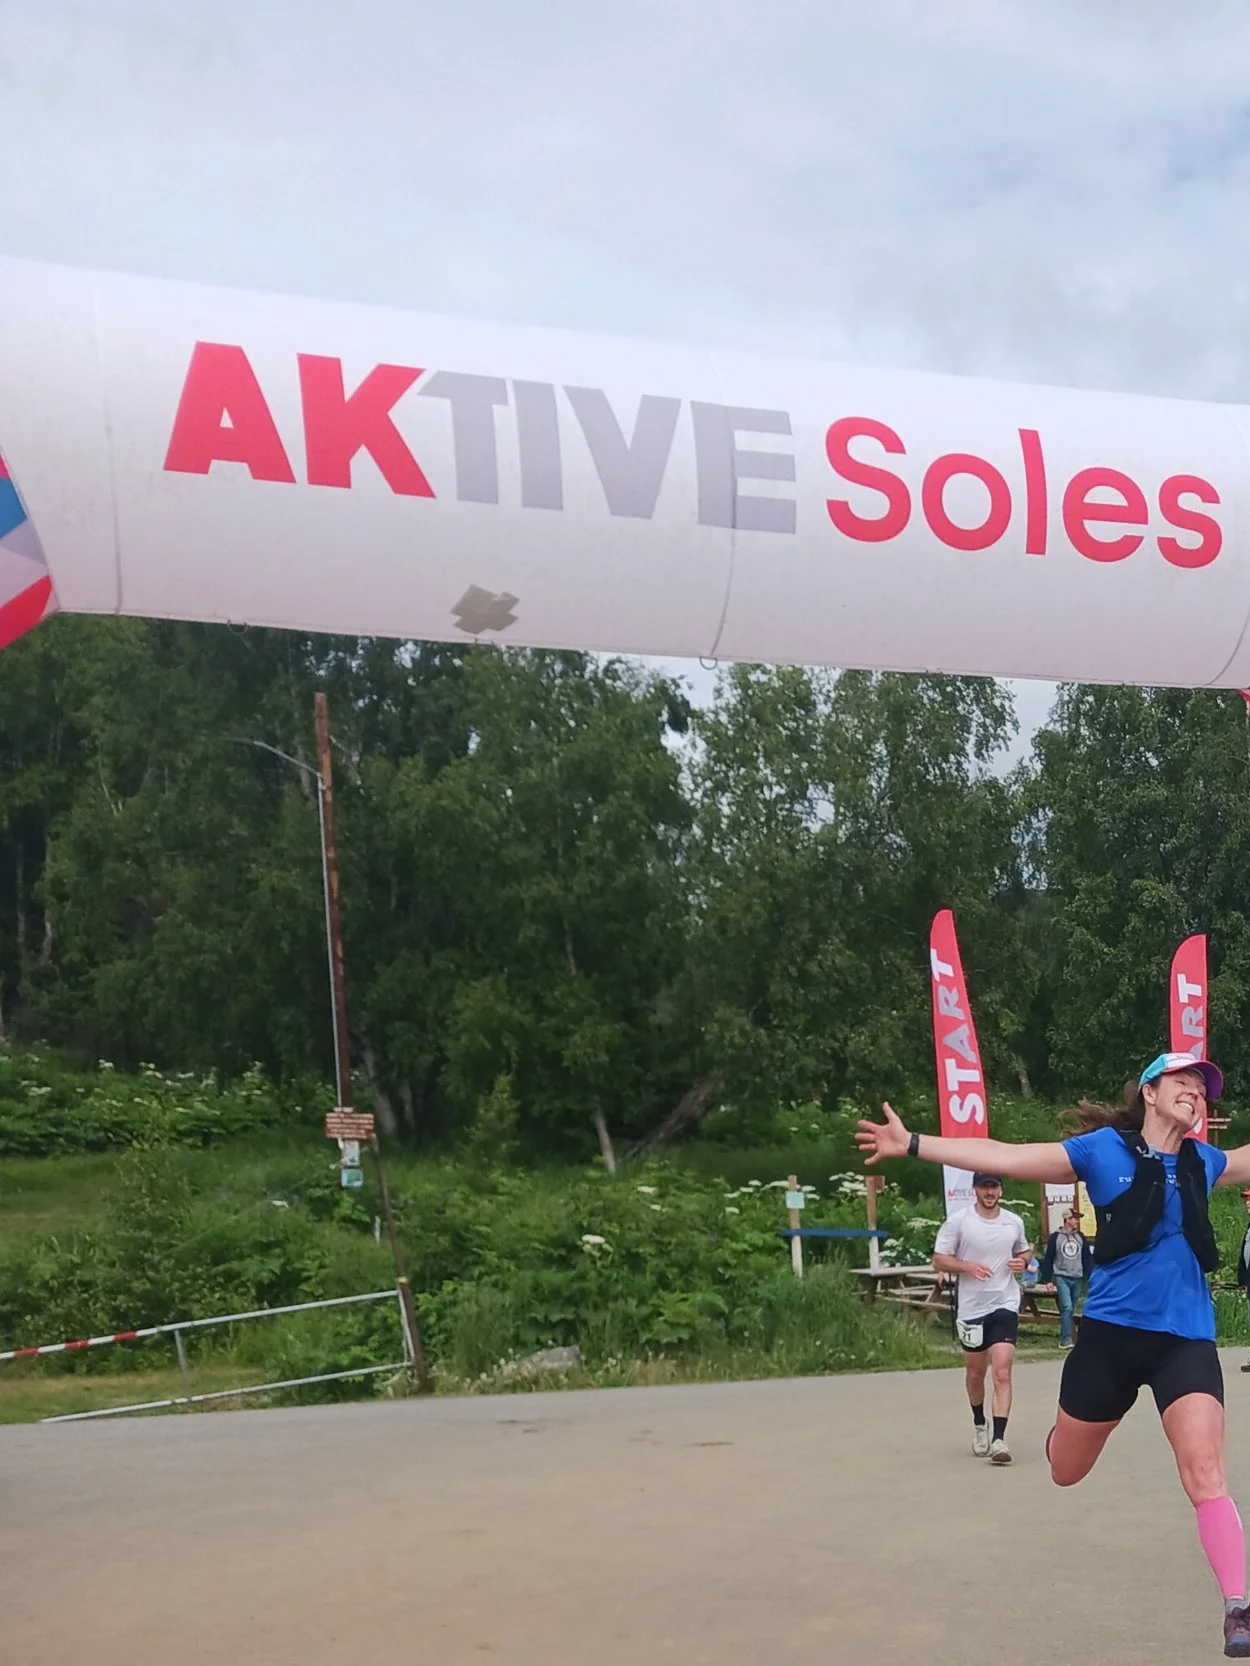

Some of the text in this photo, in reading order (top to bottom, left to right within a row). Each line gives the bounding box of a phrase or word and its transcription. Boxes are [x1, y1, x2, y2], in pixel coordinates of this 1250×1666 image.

[163, 341, 1224, 569] AKTIVE Soles
[930, 947, 985, 1125] START
